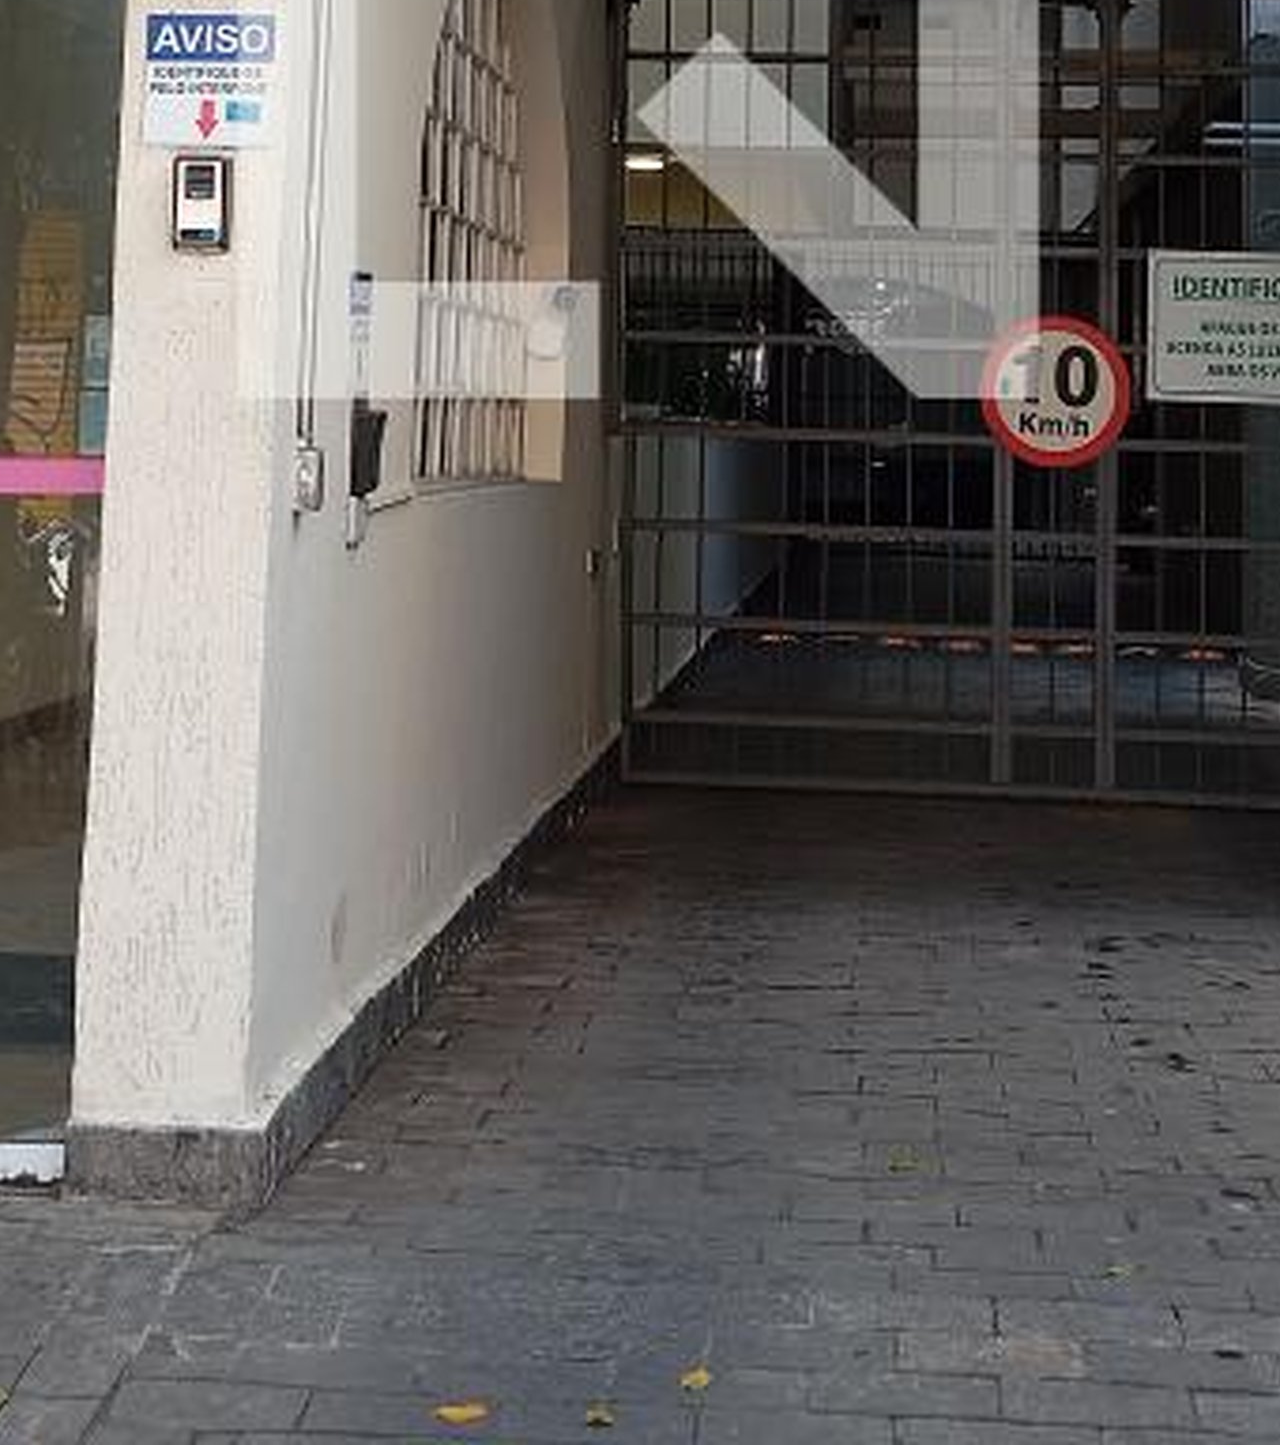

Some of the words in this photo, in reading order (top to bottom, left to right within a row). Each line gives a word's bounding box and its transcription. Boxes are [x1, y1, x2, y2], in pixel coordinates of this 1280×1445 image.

[153, 22, 269, 53] AVISO
[1012, 345, 1099, 407] 10
[1019, 411, 1090, 439] Km/h
